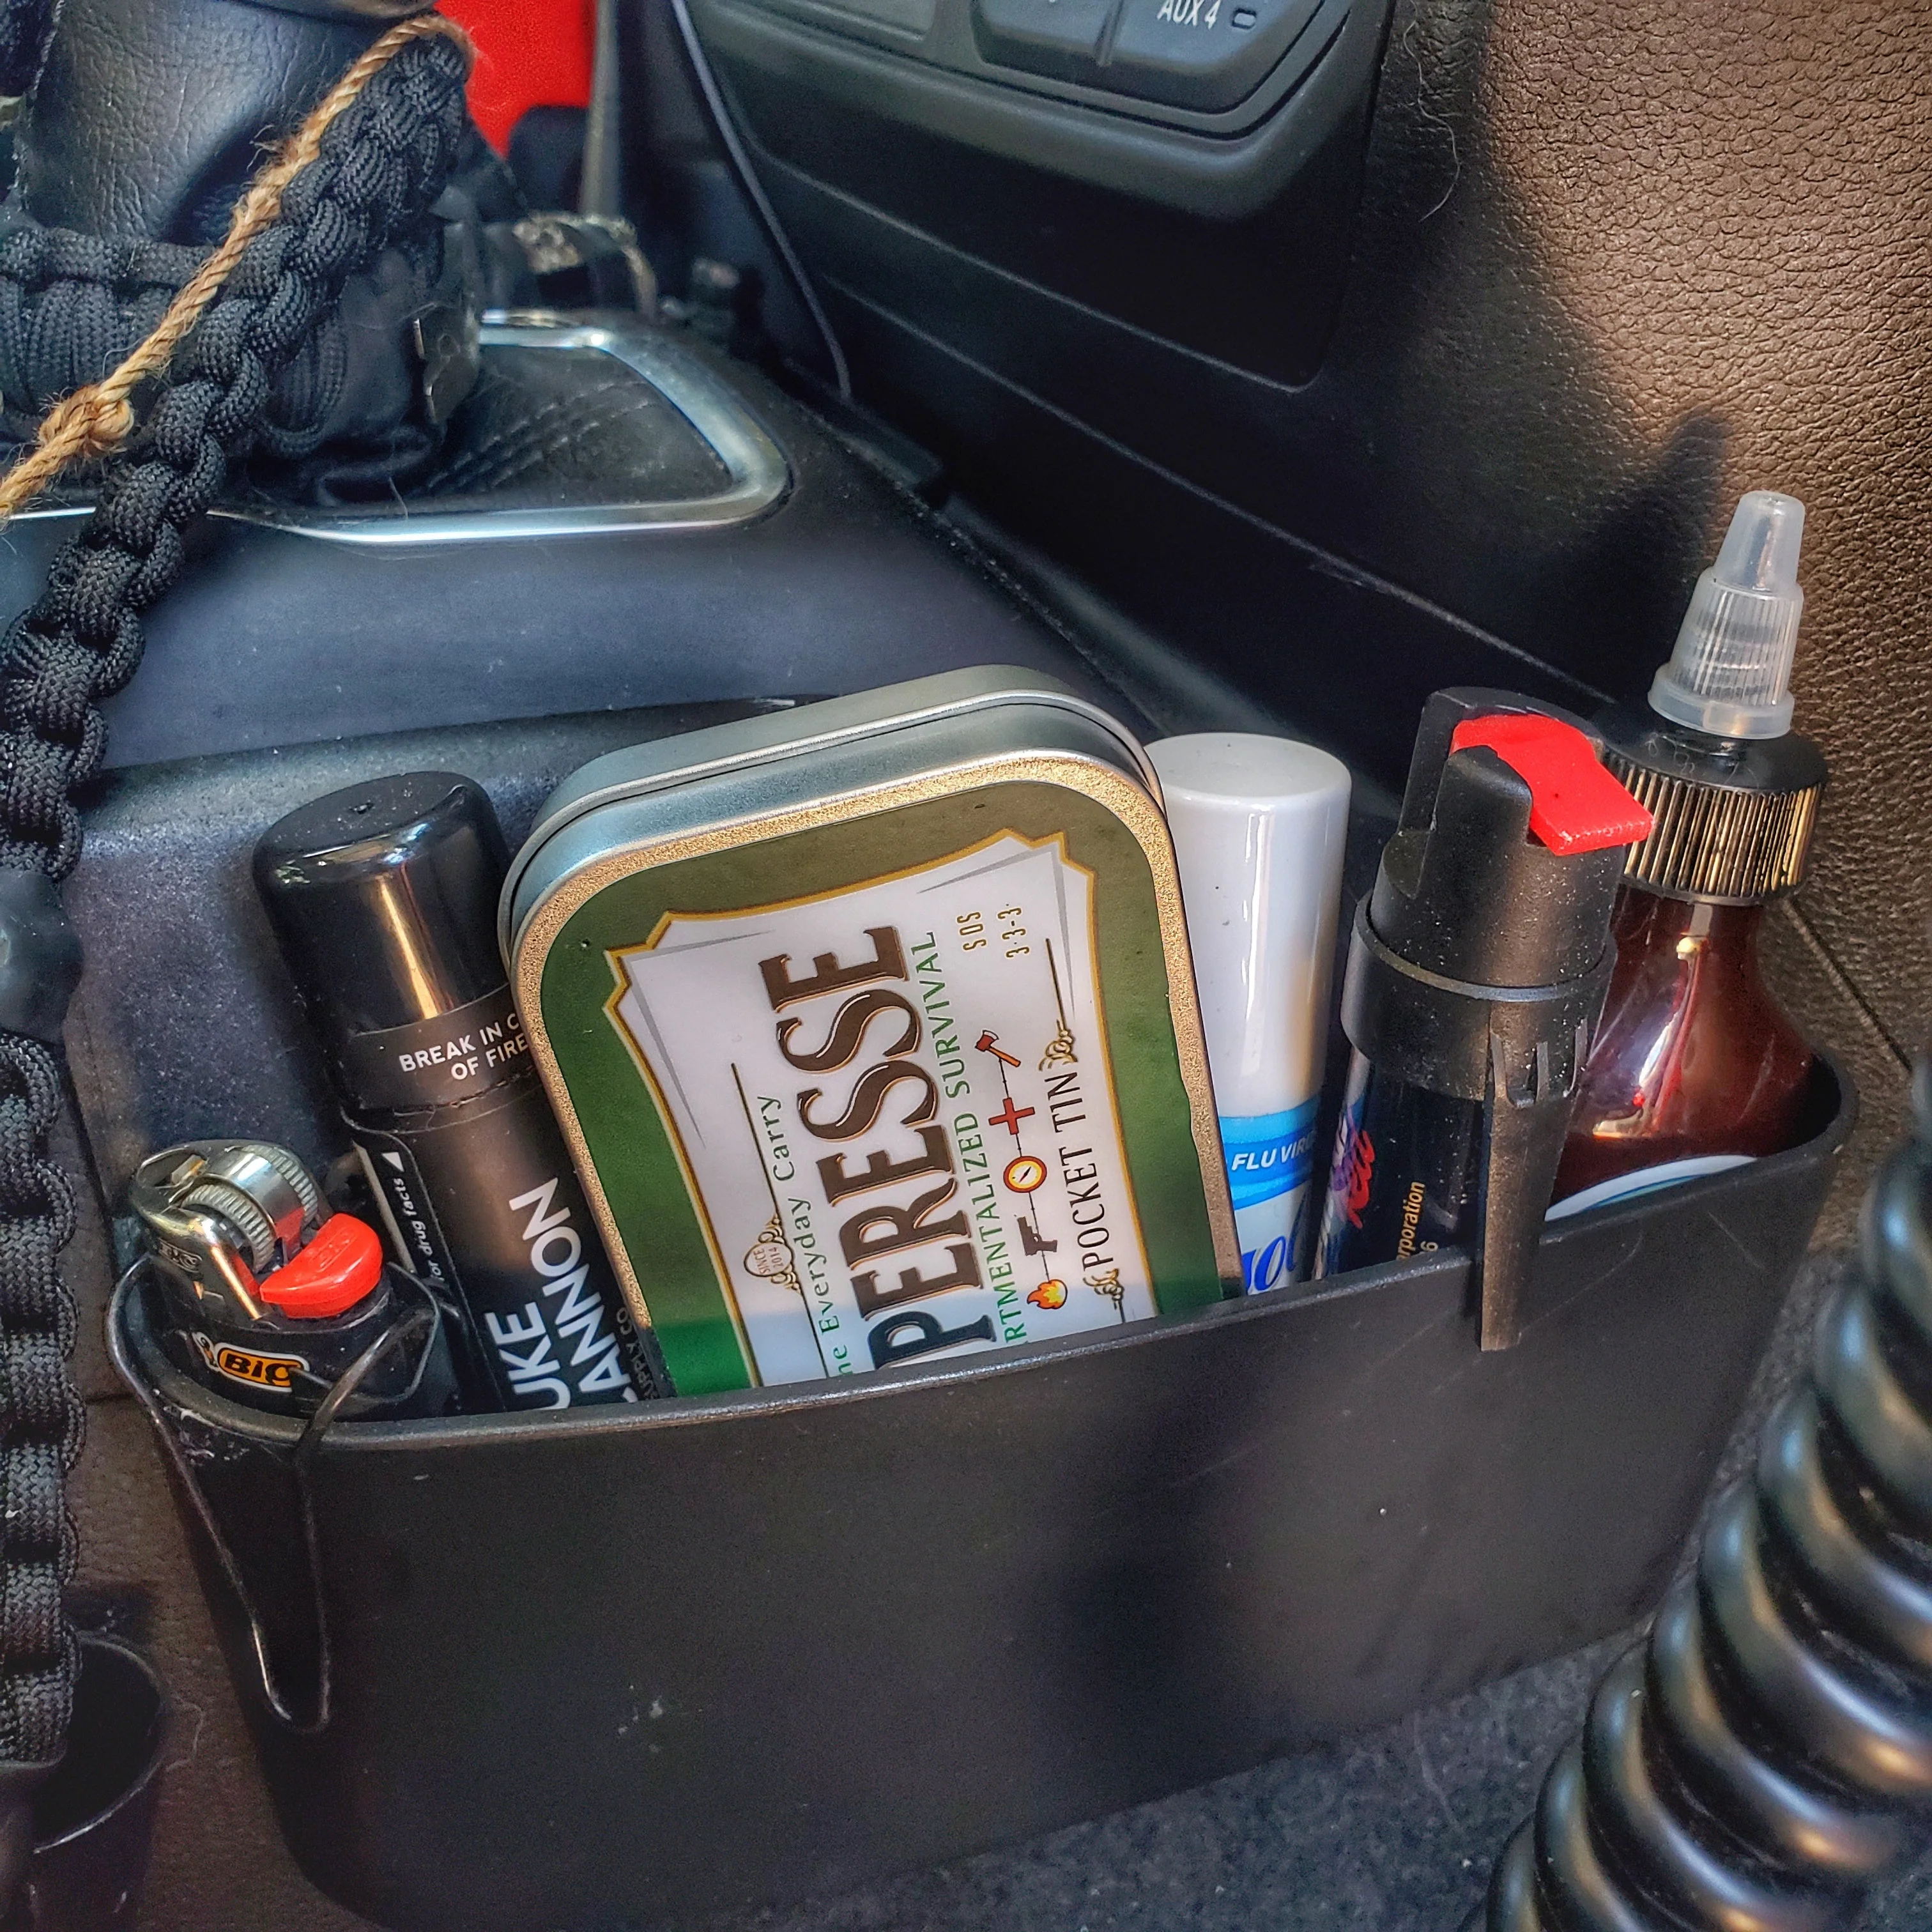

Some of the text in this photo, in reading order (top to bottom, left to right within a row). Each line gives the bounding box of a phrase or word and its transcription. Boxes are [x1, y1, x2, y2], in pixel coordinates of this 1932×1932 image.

[1156, 0, 1221, 30] AUX 4
[956, 911, 987, 951] SOS
[910, 931, 971, 1099] SURVIVAL
[399, 1013, 519, 1072] BREAK IN C
[451, 1032, 528, 1080] OF FIRE
[757, 1095, 795, 1181] Carry
[758, 924, 997, 1371] PERESSE
[1232, 1148, 1276, 1170] FLU
[393, 1177, 417, 1217] facts
[1044, 1071, 1114, 1271] POCKET TIN
[411, 1220, 433, 1257] drug
[753, 1248, 771, 1274] SINCE
[509, 1177, 638, 1404] ANNON
[788, 1197, 839, 1334] Everyday
